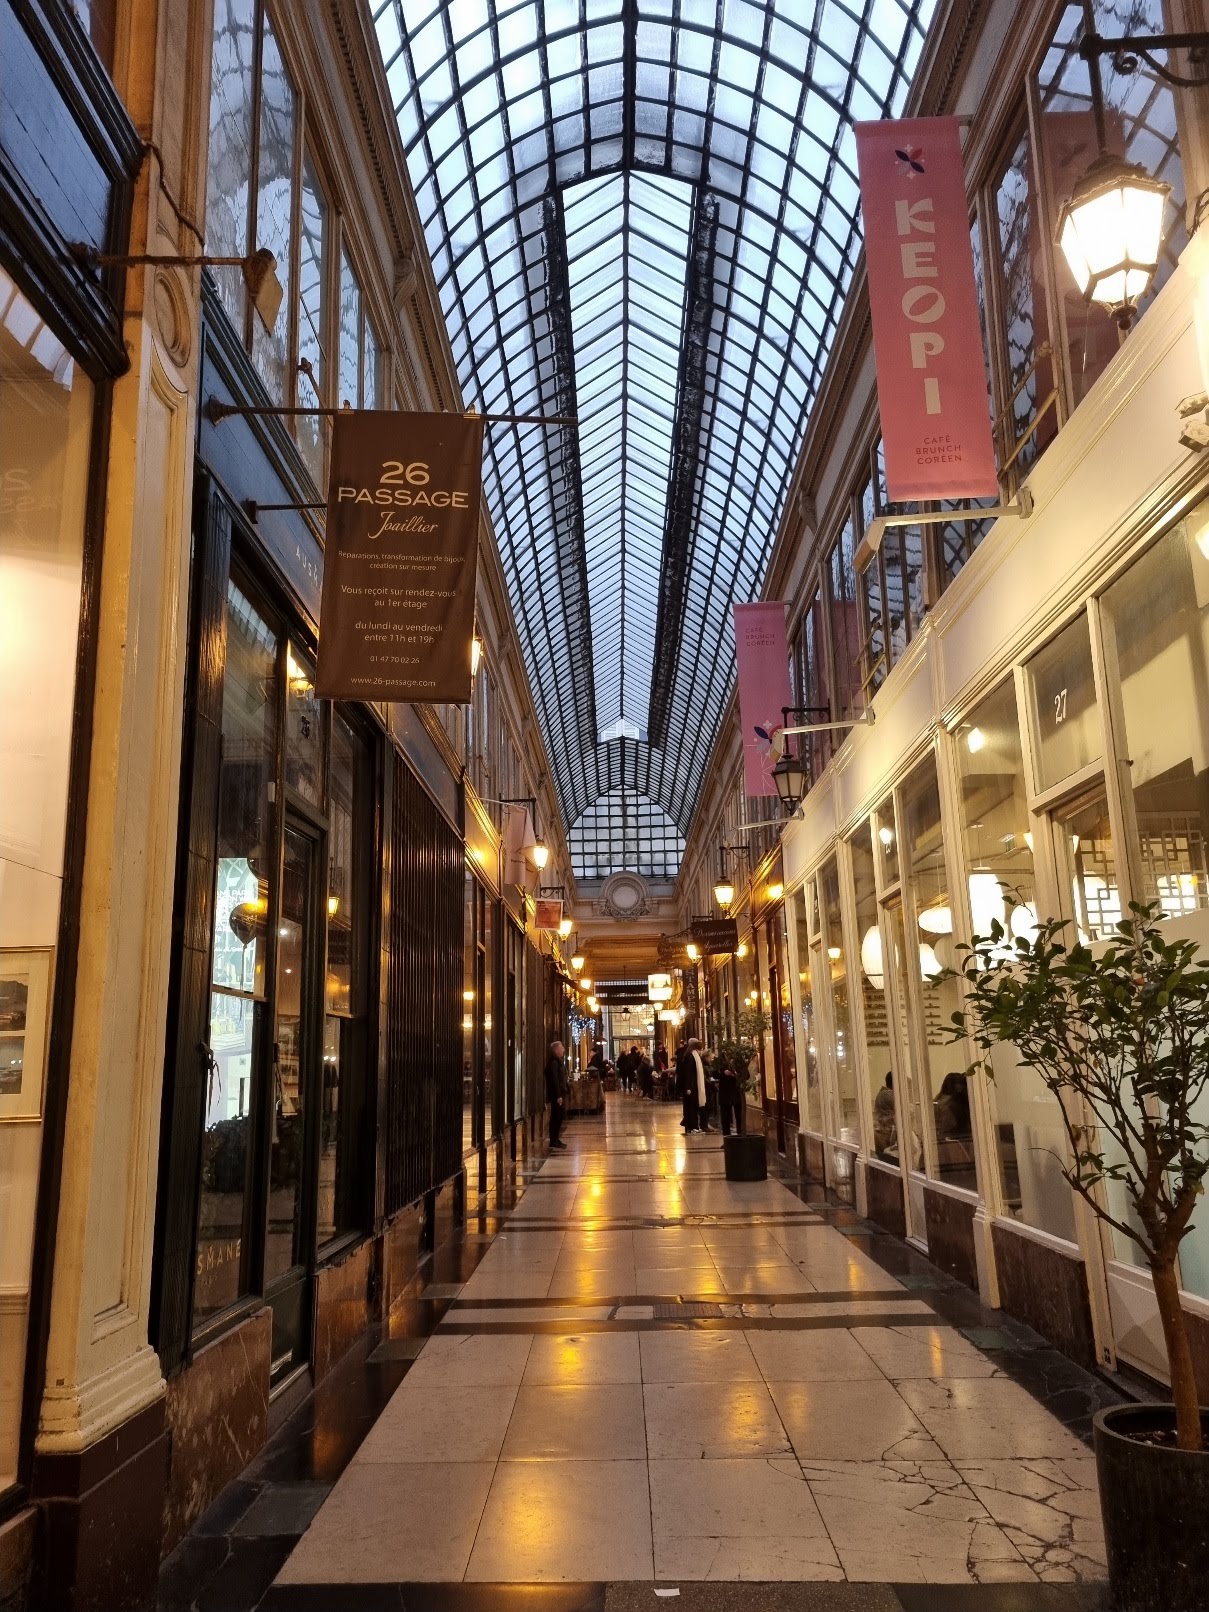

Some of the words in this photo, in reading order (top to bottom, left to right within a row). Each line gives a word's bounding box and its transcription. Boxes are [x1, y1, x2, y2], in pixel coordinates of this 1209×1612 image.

[895, 198, 946, 415] KEOPI
[924, 434, 951, 444] CAFÉ
[915, 445, 961, 454] BRUNCH
[380, 461, 430, 485] 26
[338, 487, 469, 508] PASSAGE
[368, 511, 438, 539] Joaillier
[382, 553, 431, 562] transformation
[340, 585, 362, 594] Vous
[364, 586, 388, 597] reçoit
[390, 588, 404, 596] sur
[405, 589, 457, 598] rendez-vous
[388, 599, 401, 607] 1er
[355, 621, 367, 630] du
[368, 621, 391, 630] lundi
[405, 623, 443, 632] vendredi
[364, 634, 388, 642] entre
[389, 634, 406, 642] 11h
[407, 635, 416, 643] et
[419, 635, 435, 644] 19h
[350, 677, 436, 688] www.26-passage.com
[1054, 688, 1067, 724] 27
